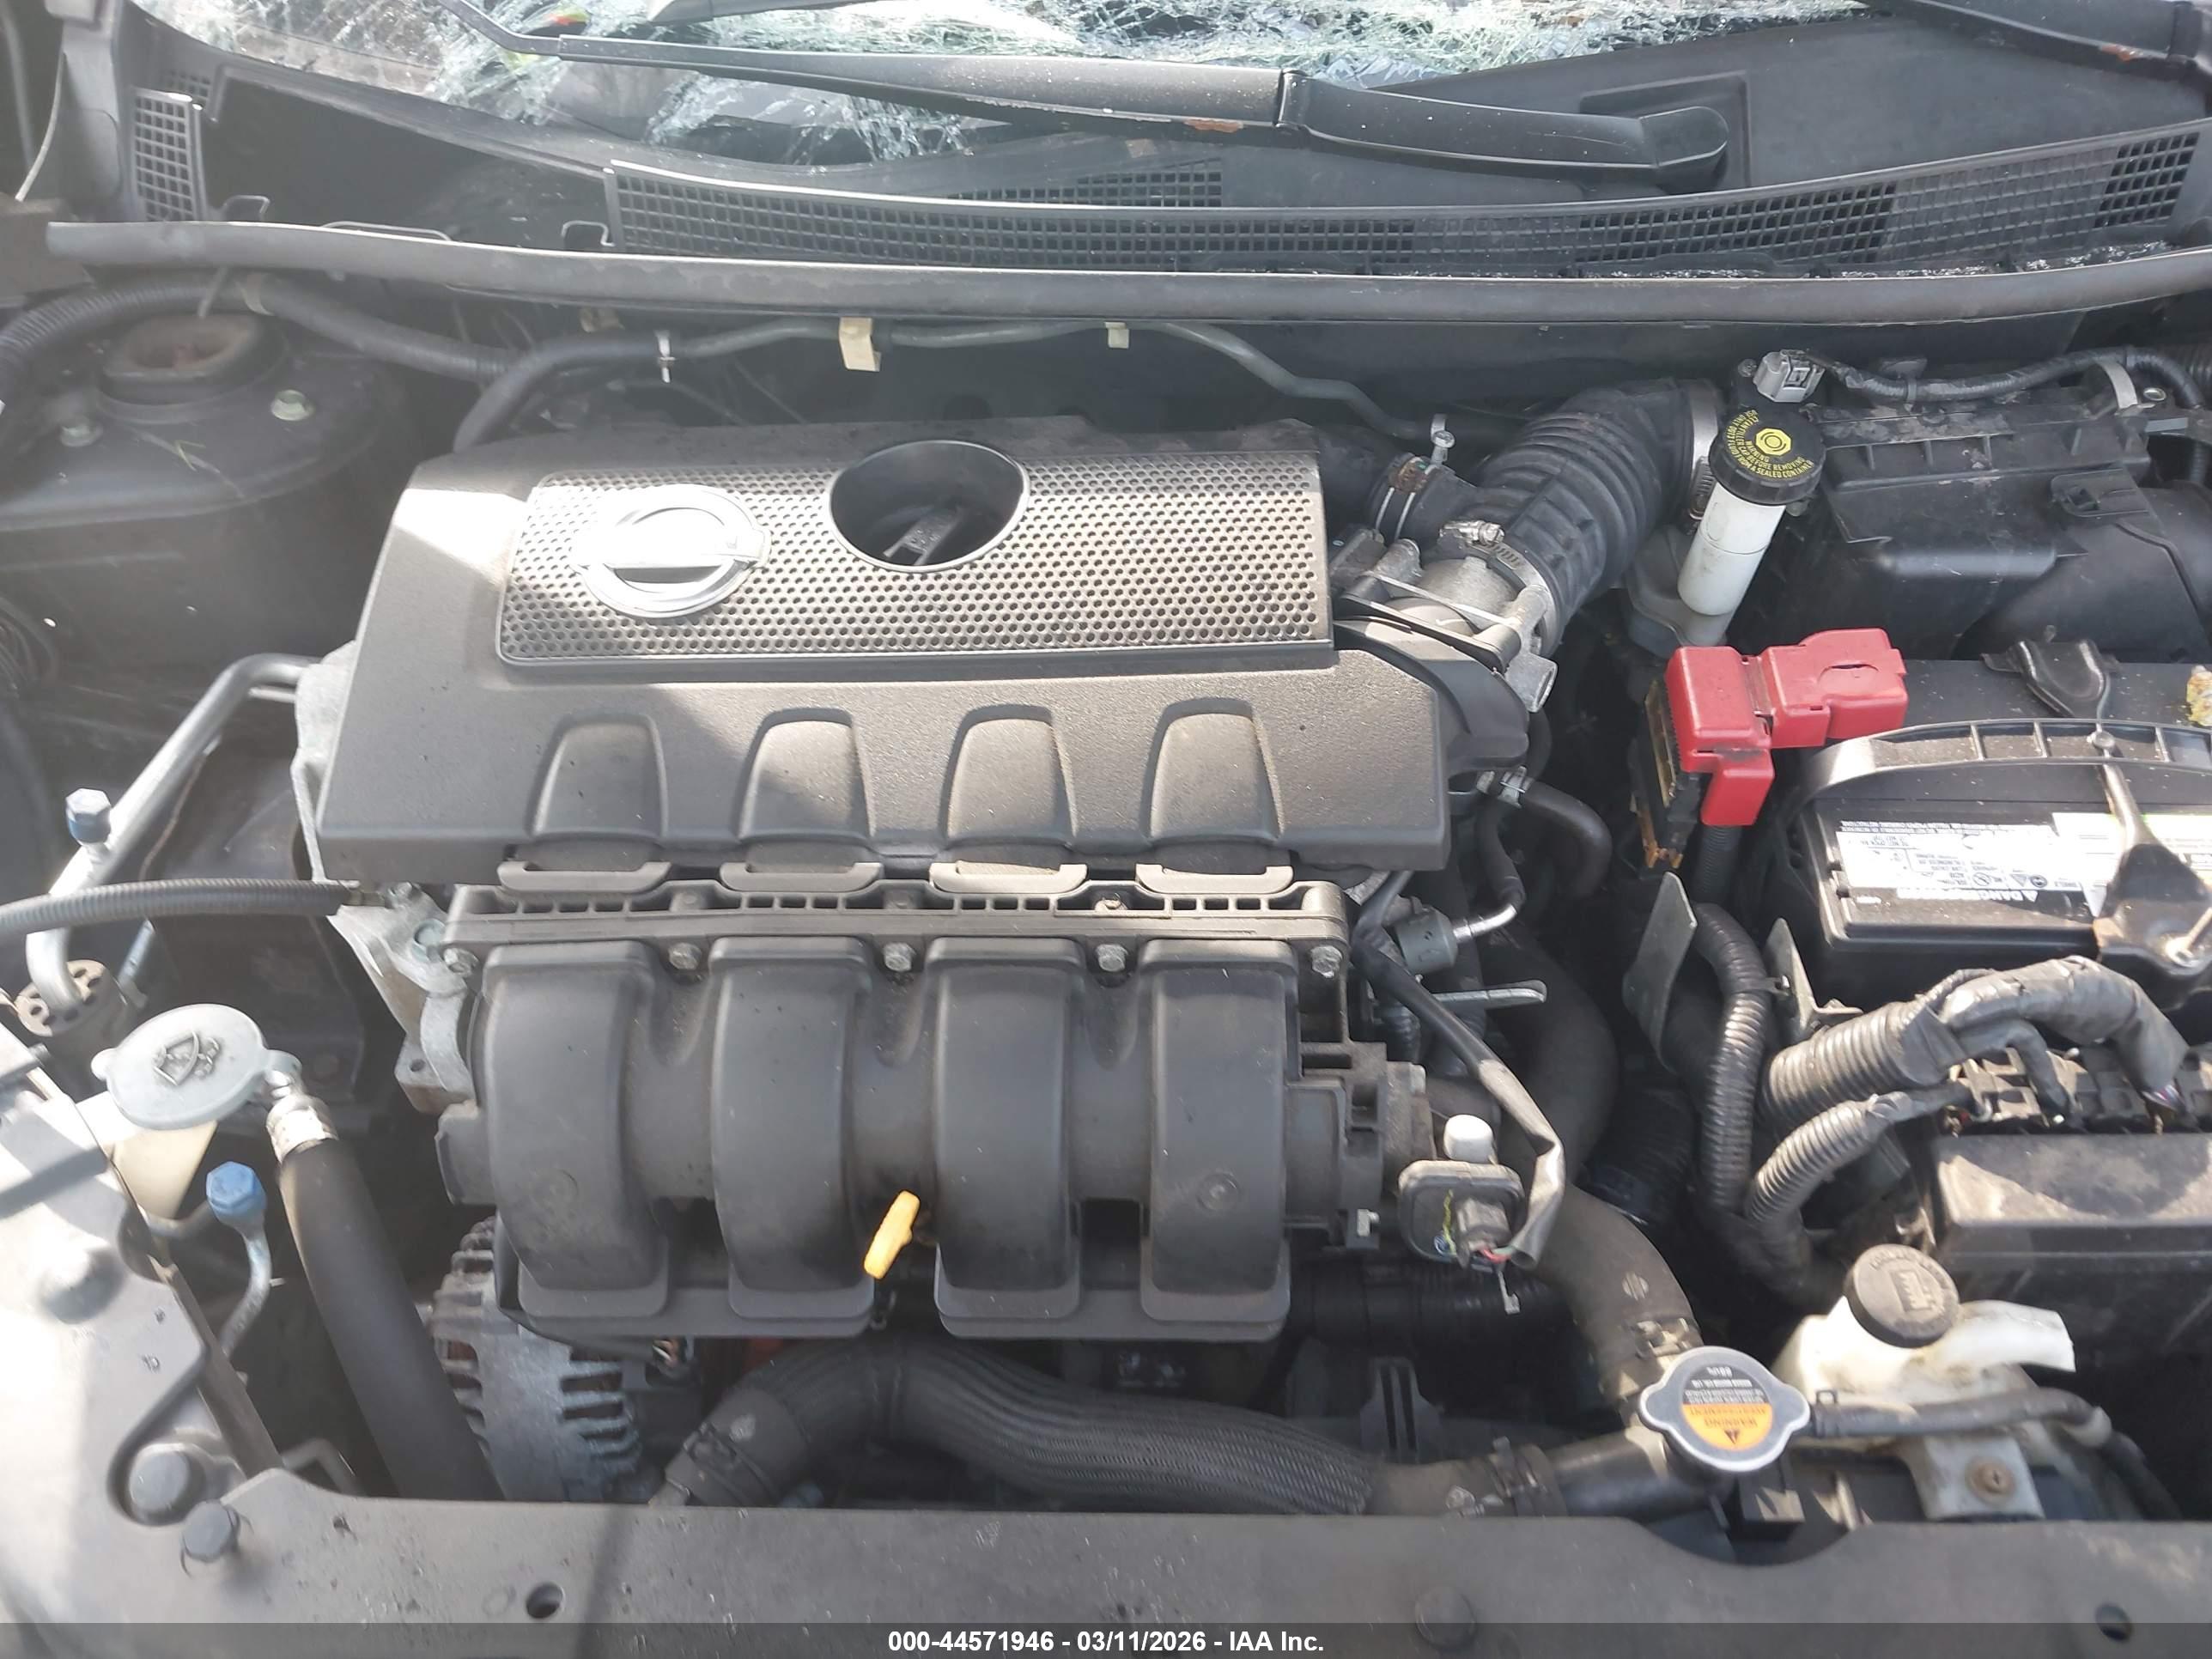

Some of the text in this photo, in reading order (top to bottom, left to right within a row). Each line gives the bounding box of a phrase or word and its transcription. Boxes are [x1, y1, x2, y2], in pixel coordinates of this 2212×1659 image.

[1741, 446, 1751, 457] CAP
[1747, 455, 1771, 471] BEFORE
[1772, 456, 1807, 471] REMOVING
[1747, 441, 1770, 462] WARNING
[1735, 454, 1751, 468] FROM
[1756, 467, 1783, 478] SEALED
[1783, 460, 1814, 478] CONTAINER
[1704, 1417, 1758, 1429] WARNING
